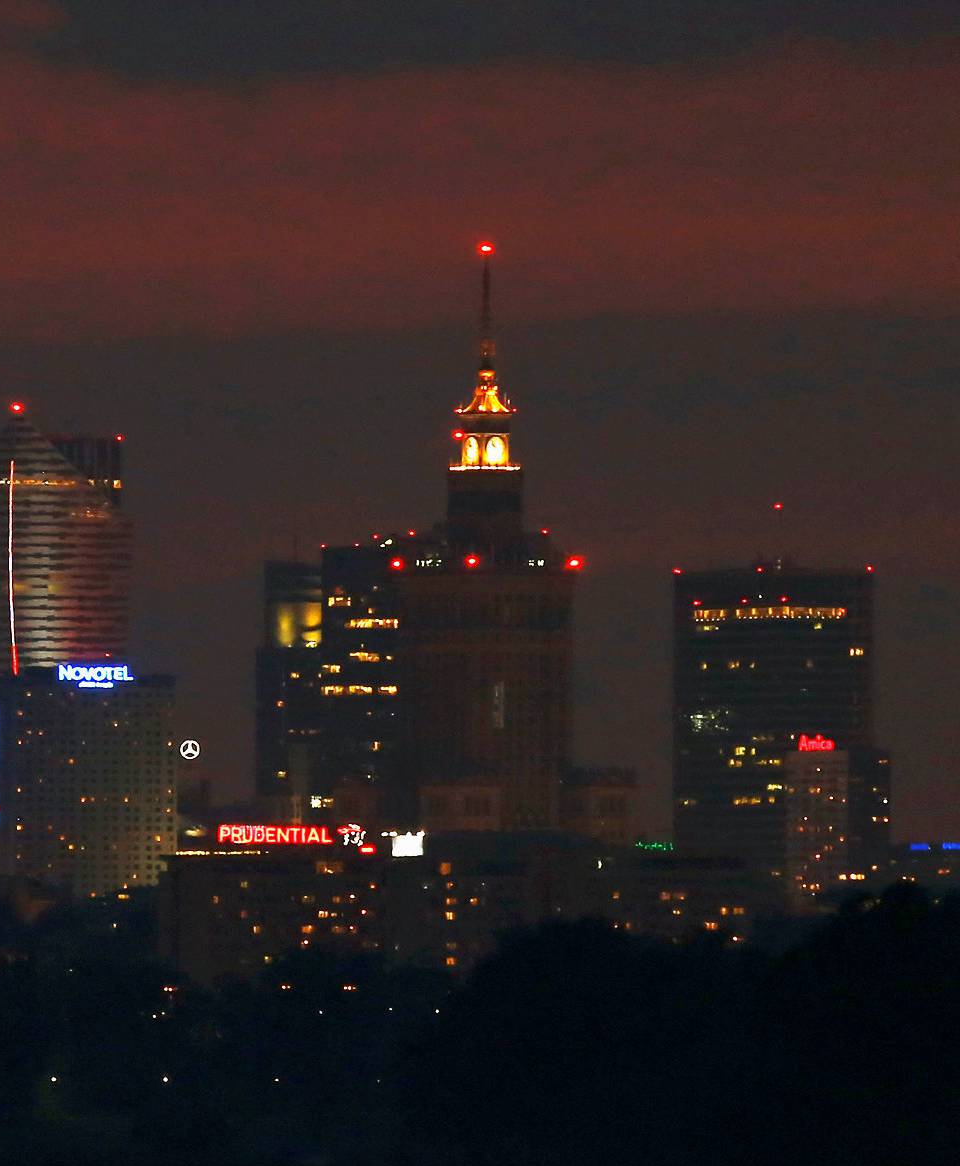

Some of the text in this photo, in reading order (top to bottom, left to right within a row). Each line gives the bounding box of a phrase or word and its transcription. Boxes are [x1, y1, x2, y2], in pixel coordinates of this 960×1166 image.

[58, 664, 134, 681] NOVOTEL
[798, 733, 834, 751] Amica
[218, 825, 333, 844] PRUDENTIAL
